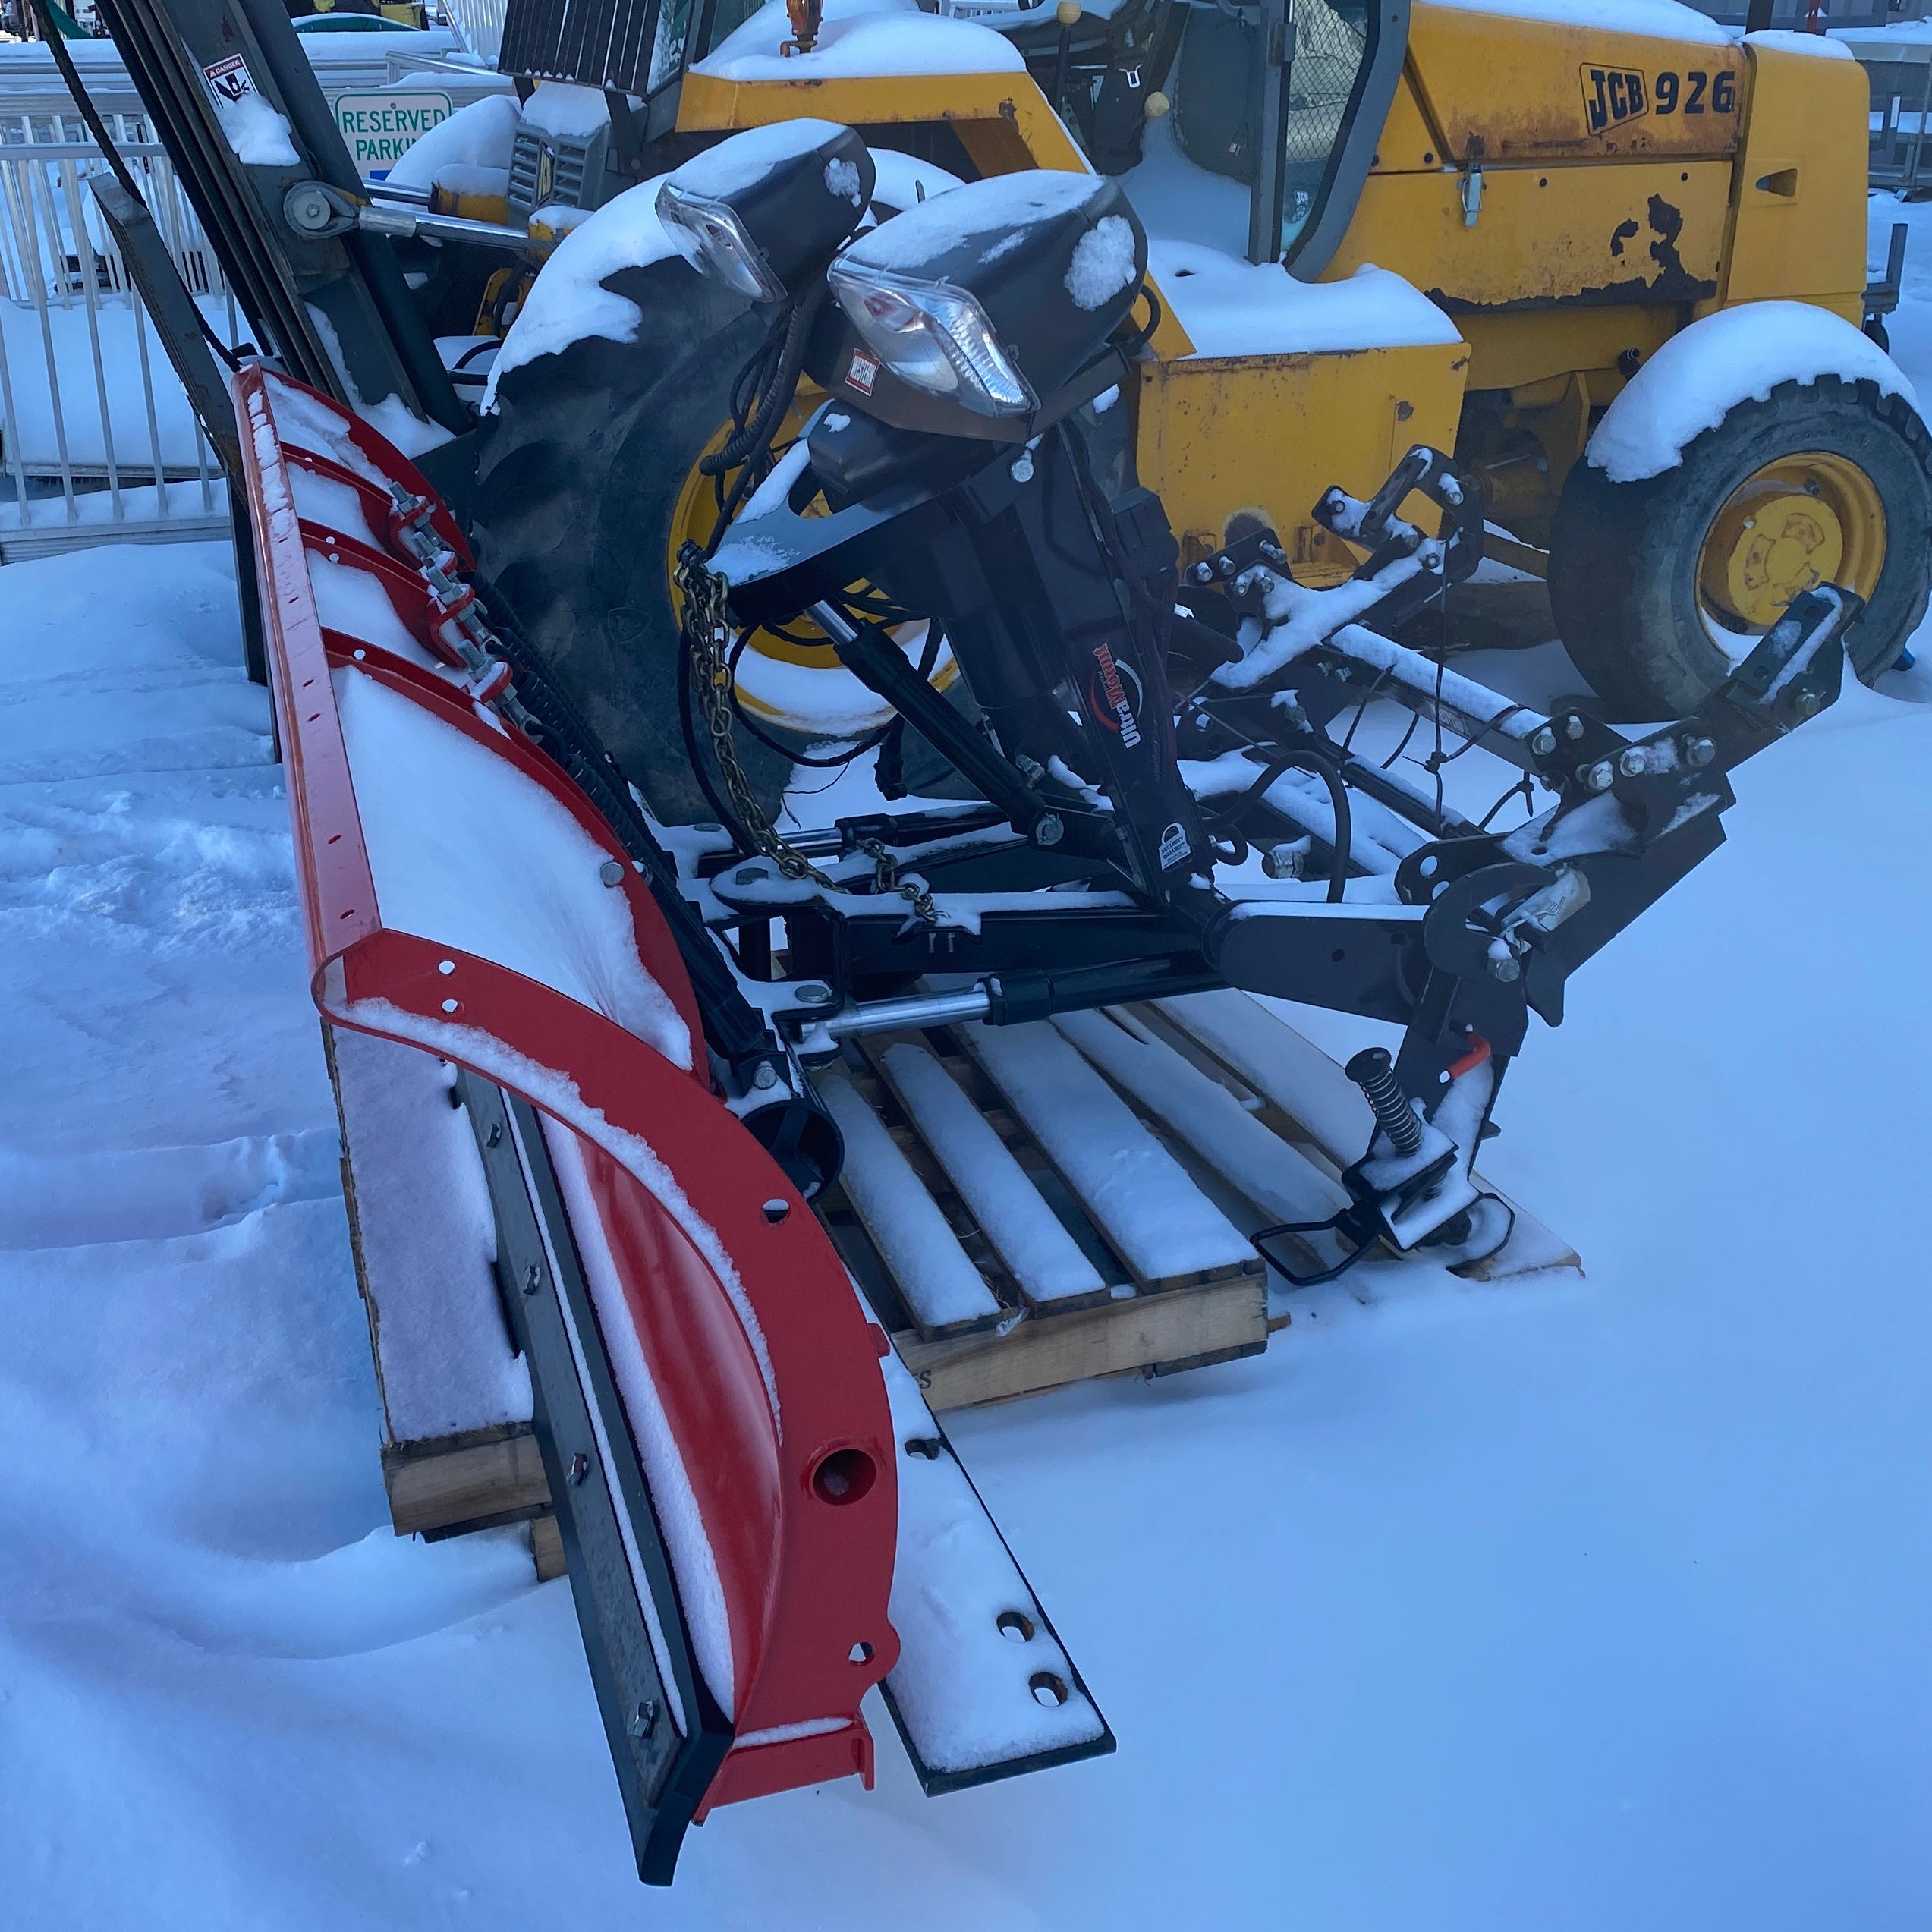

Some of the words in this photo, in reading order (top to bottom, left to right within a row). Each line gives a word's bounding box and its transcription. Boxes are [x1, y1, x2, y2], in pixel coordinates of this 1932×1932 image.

[215, 59, 241, 74] DANGER
[1589, 69, 1644, 130] JCB
[1656, 71, 1735, 115] 926
[342, 109, 445, 133] RESERVED
[1093, 643, 1141, 748] UltraMount
